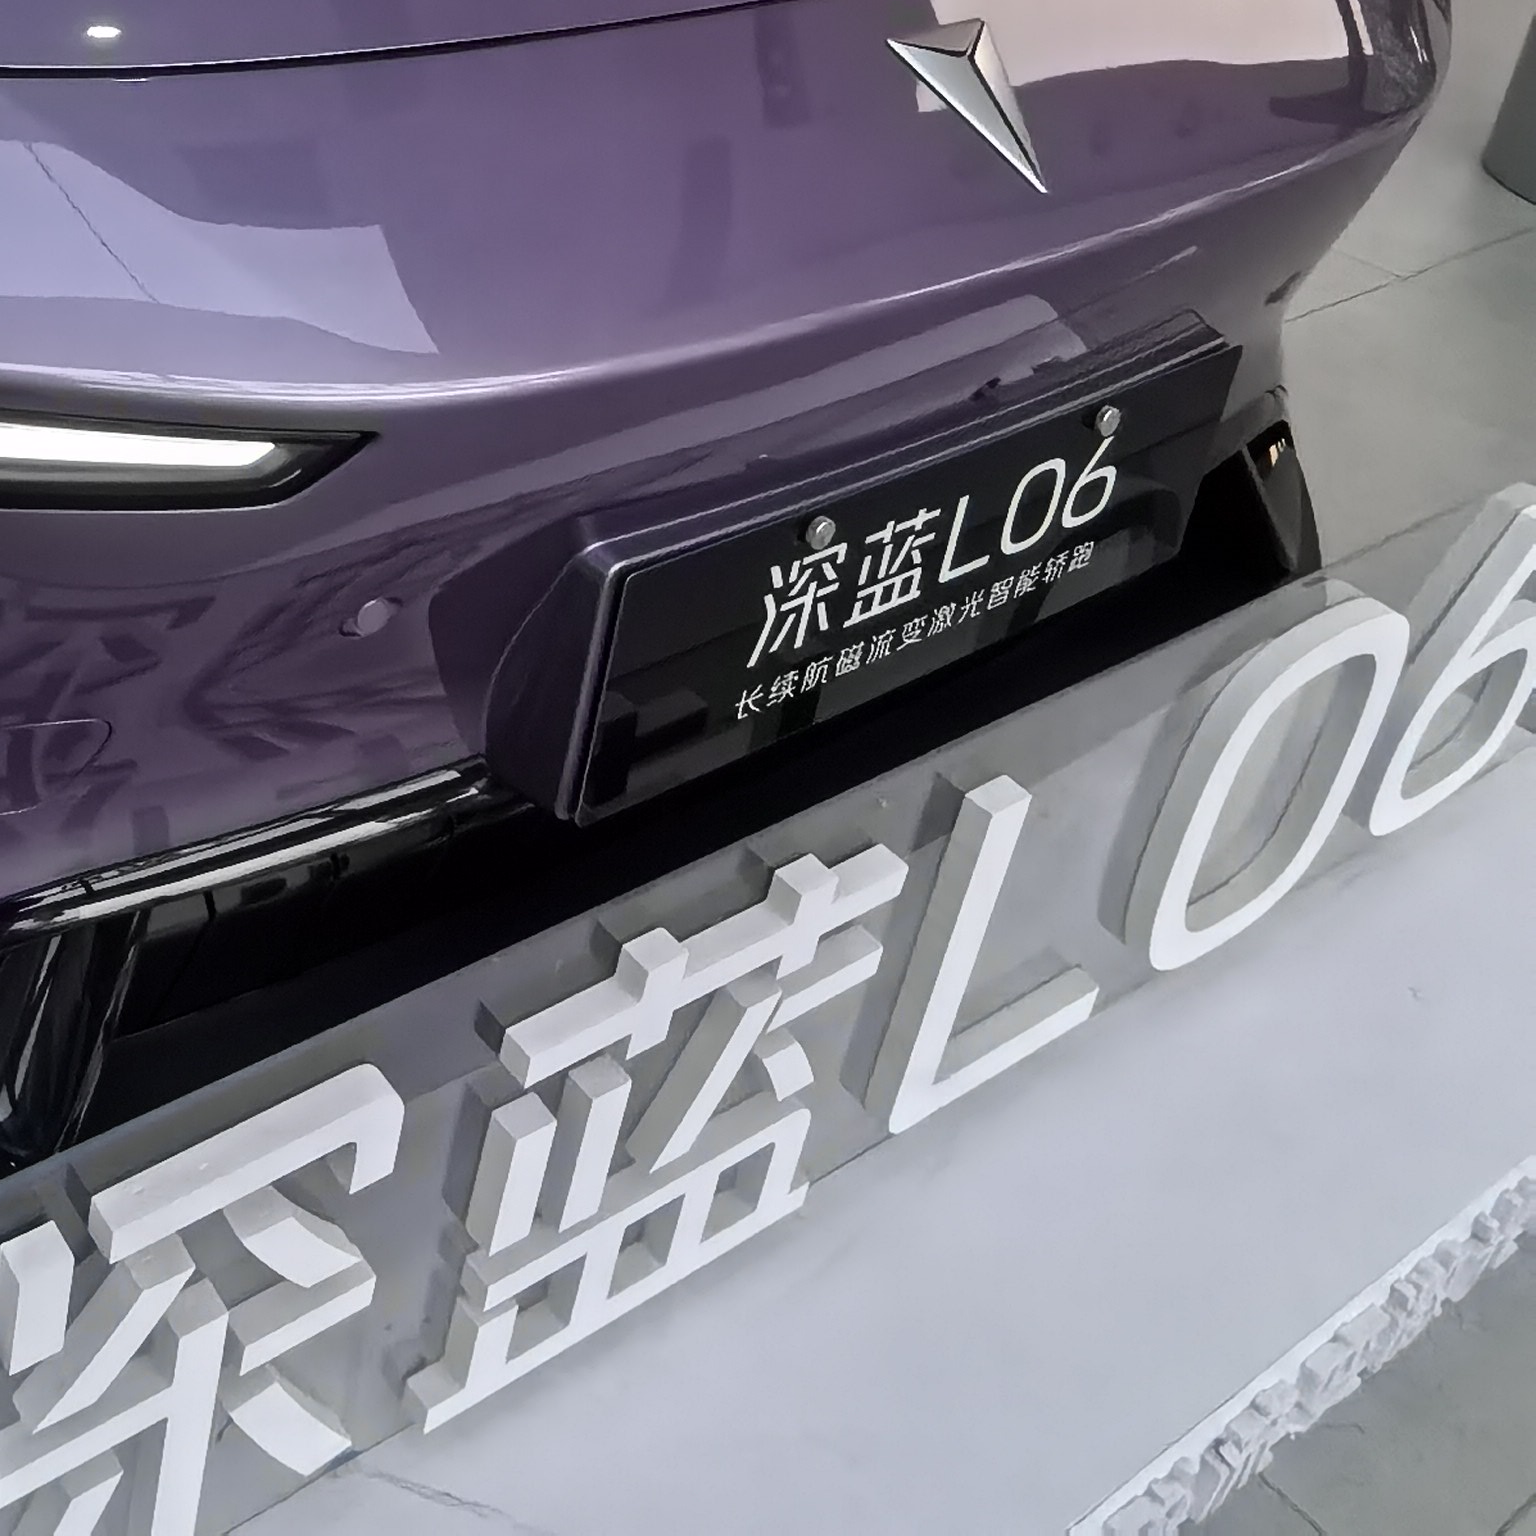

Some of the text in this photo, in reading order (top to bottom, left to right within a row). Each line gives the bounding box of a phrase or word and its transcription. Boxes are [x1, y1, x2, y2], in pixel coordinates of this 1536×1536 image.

[735, 541, 1095, 720] 长续航磁流变激光智能轿跑
[747, 436, 1117, 668] 深蓝L06
